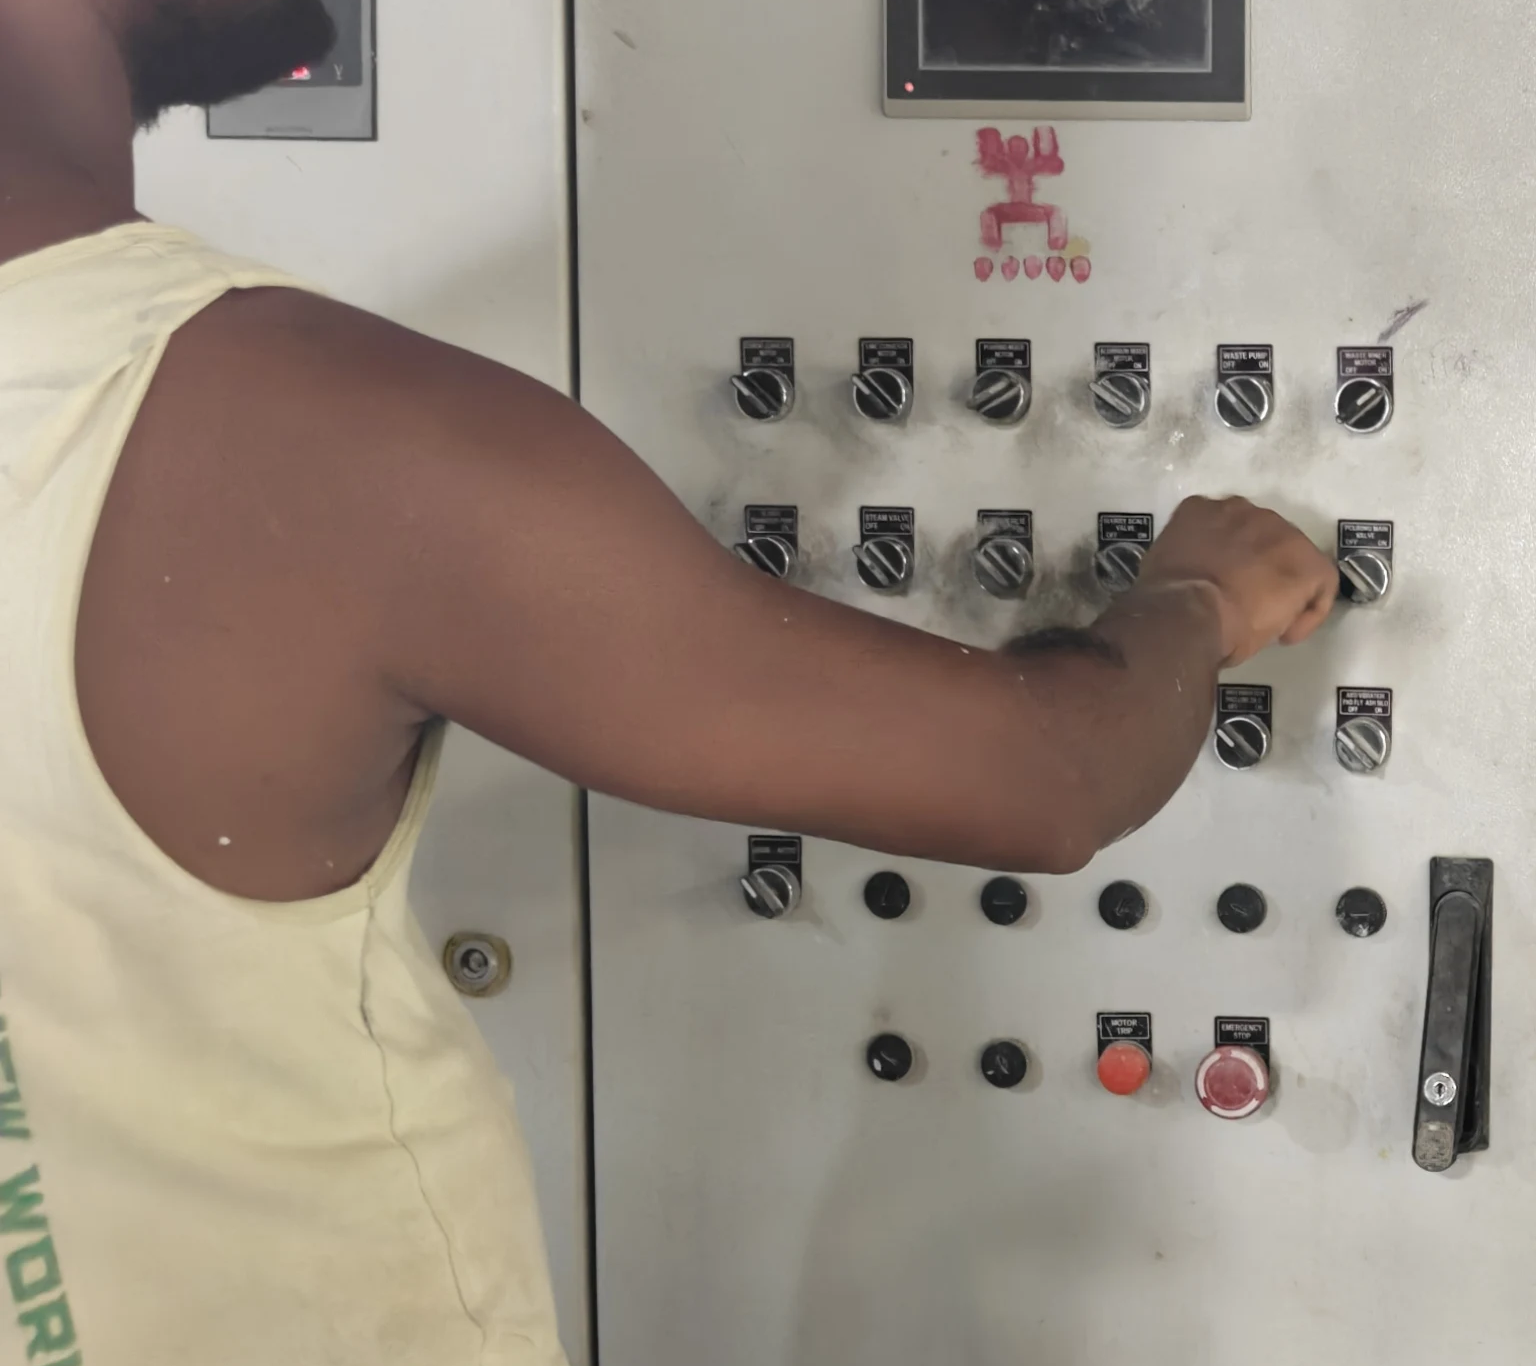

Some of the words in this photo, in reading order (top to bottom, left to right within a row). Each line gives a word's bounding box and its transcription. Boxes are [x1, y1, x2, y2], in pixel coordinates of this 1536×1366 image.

[1223, 351, 1247, 360] WASTE
[1248, 351, 1268, 360] PUMP
[1223, 360, 1235, 369] OFF
[1258, 360, 1269, 368] ON
[1345, 366, 1357, 374] OFF
[864, 513, 888, 522] STEAM
[888, 513, 909, 522] VALVE
[1111, 1019, 1138, 1027] MOTOR
[1221, 1023, 1262, 1032] EMERGENCY
[1116, 1027, 1133, 1035] TRIP
[1233, 1031, 1251, 1040] STOP
